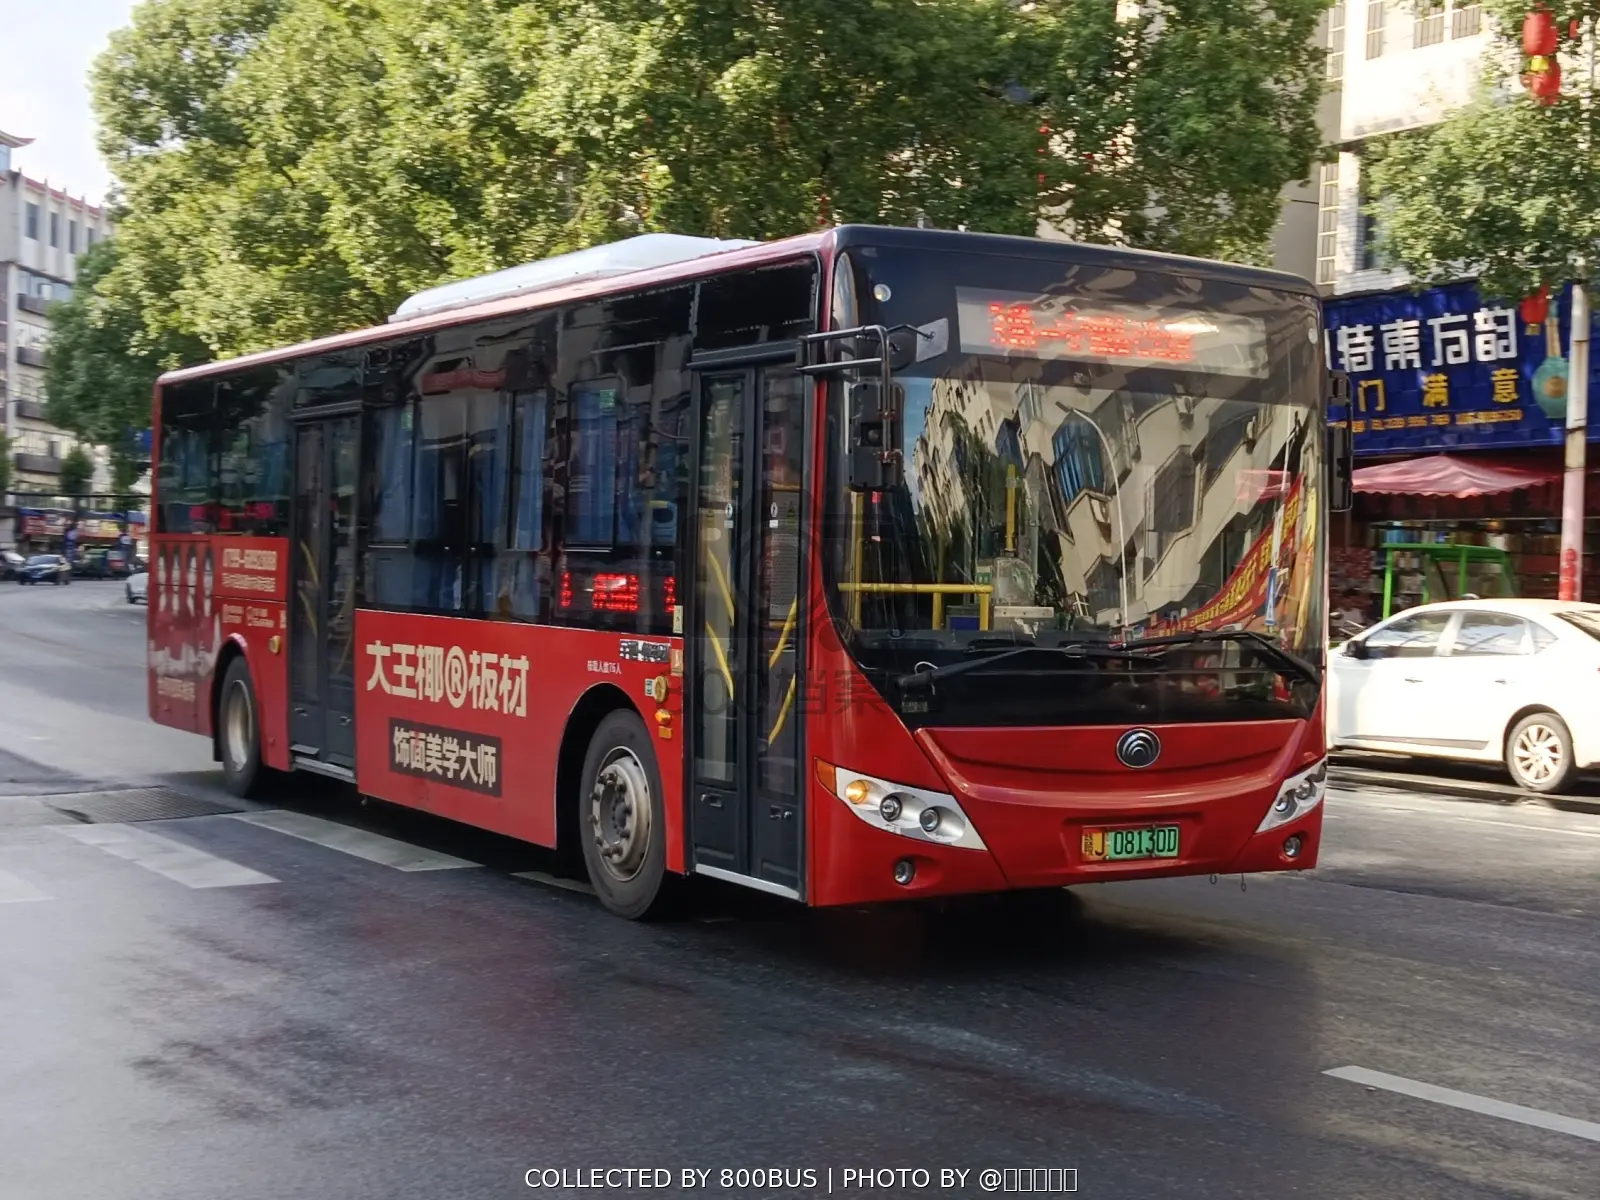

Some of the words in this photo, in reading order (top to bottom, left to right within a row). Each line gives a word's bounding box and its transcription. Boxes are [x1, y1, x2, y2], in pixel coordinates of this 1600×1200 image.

[393, 726, 497, 788] 饰面美学大师
